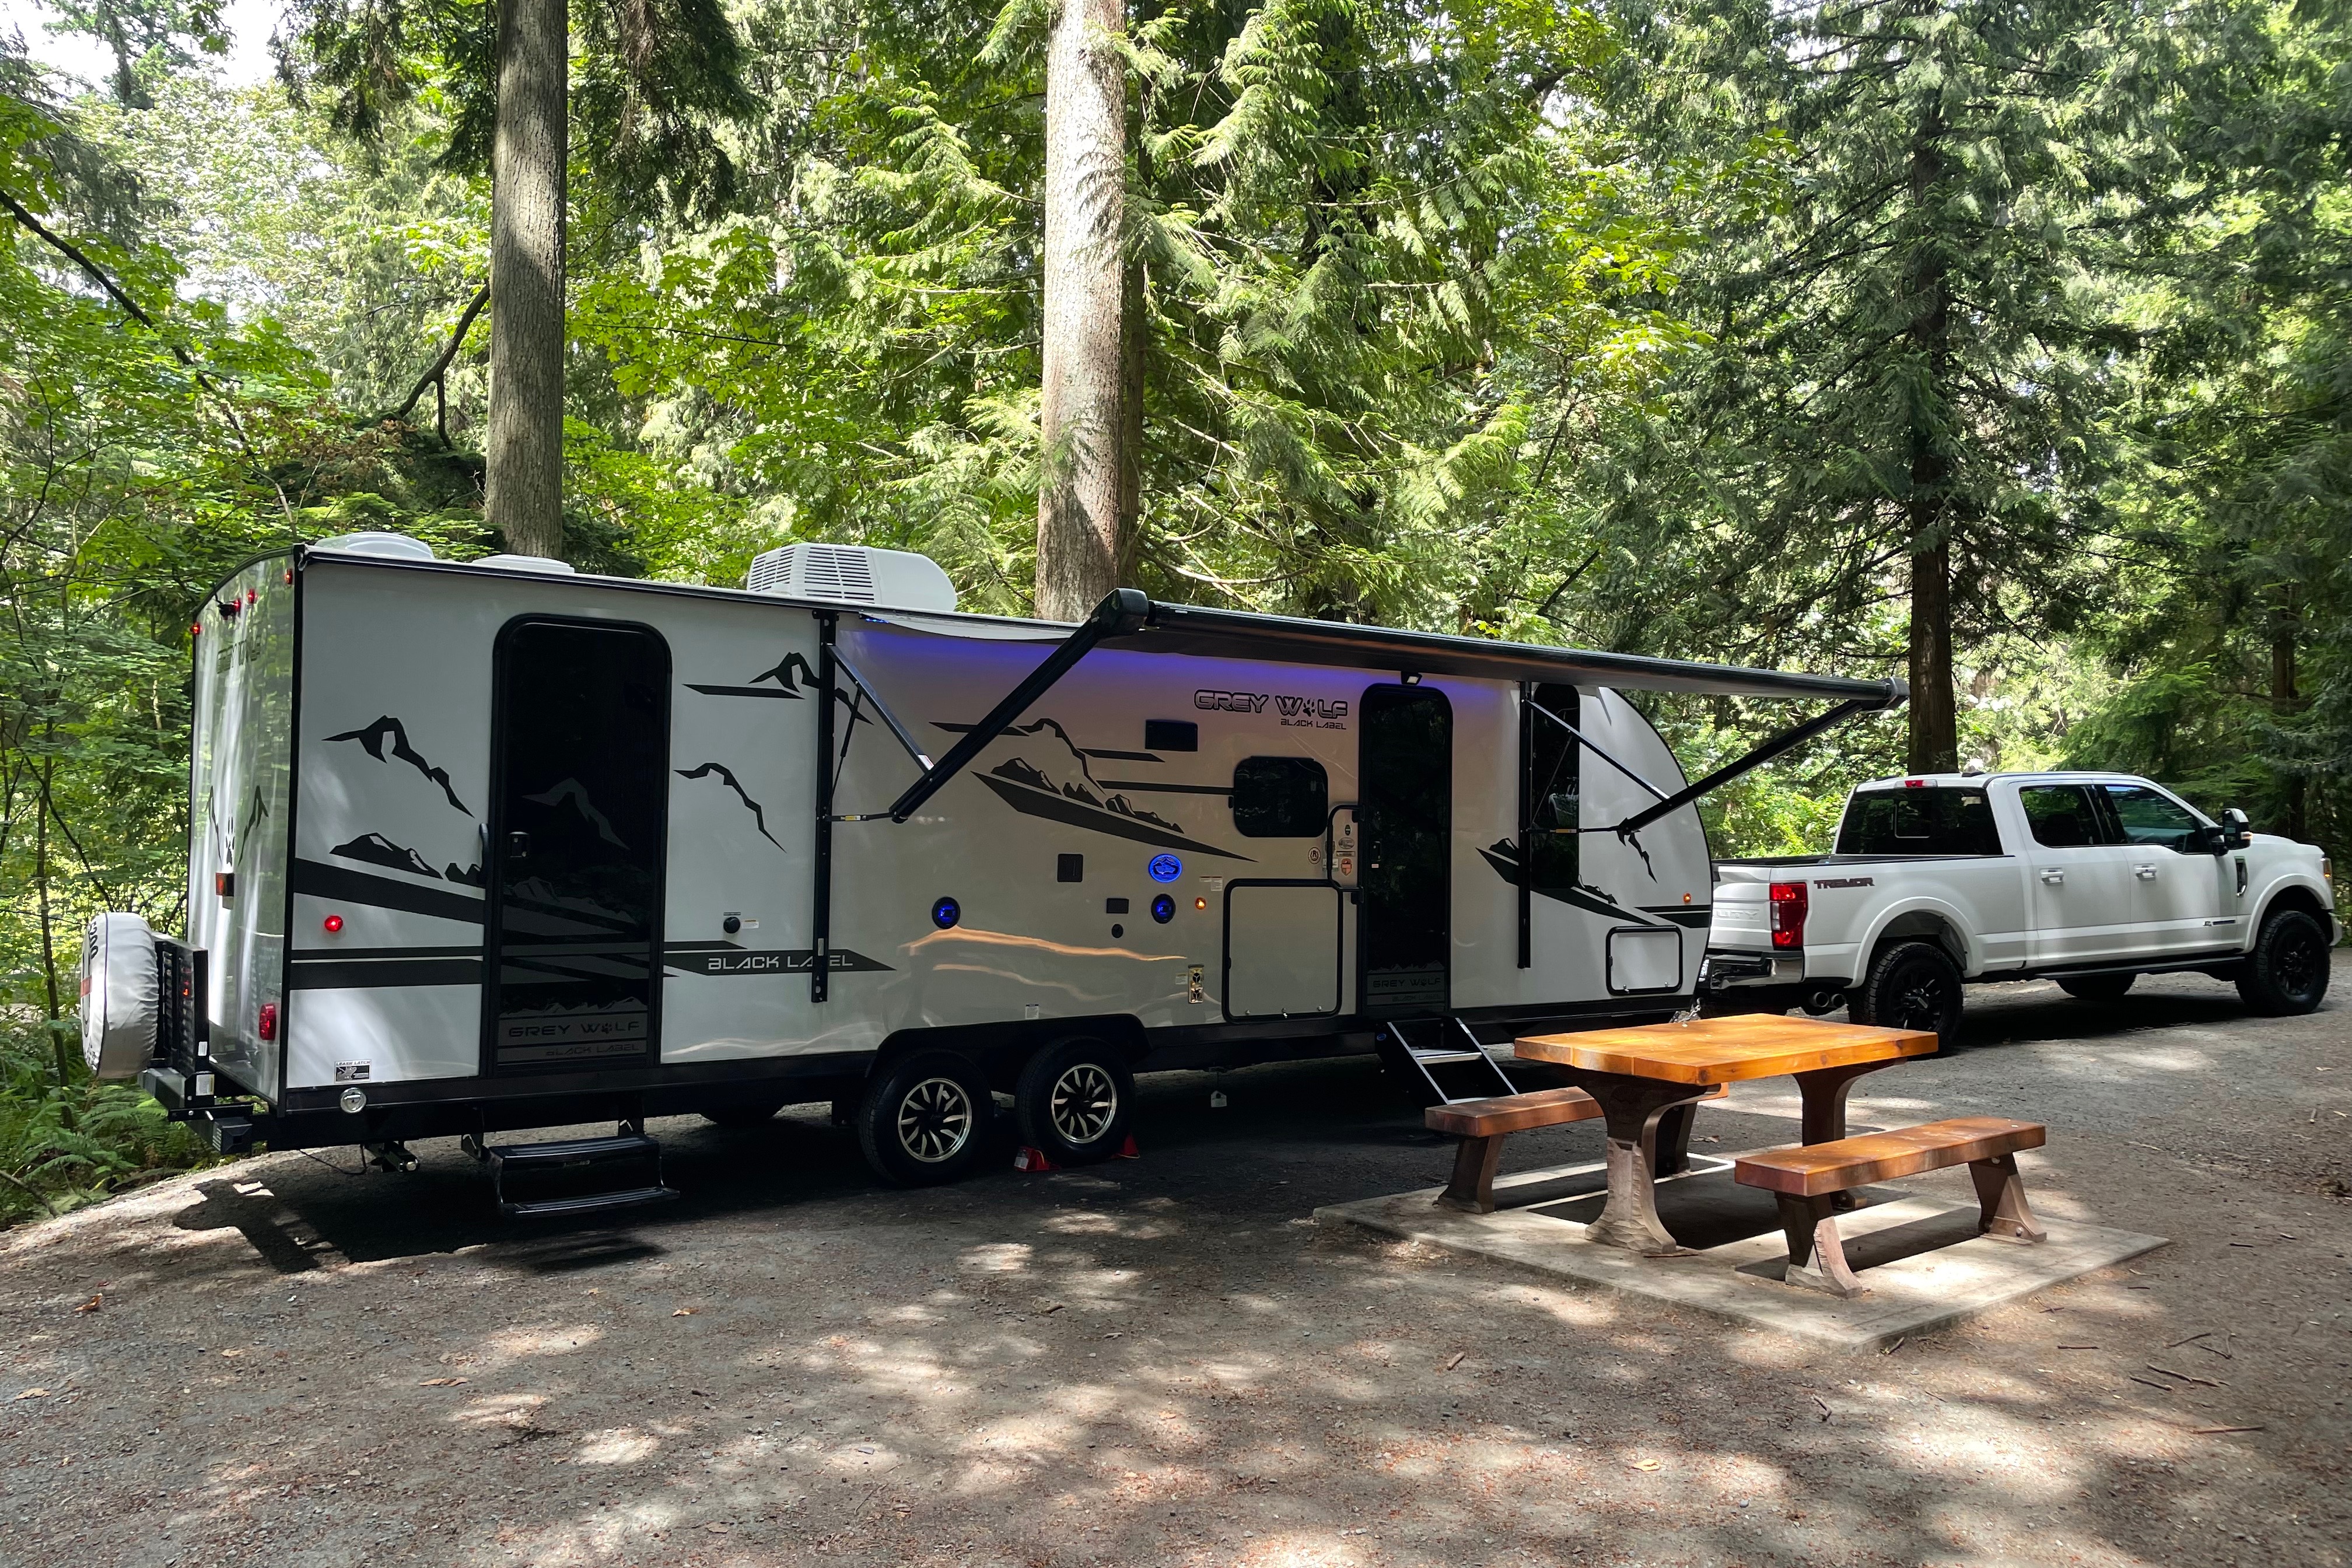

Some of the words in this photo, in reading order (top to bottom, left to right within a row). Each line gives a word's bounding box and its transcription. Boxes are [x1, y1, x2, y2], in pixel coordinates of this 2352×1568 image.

[1194, 689, 1269, 713] GREY
[1280, 718, 1313, 727] BLACK
[1316, 721, 1347, 730] LABEL
[1814, 877, 1875, 889] TREMOR
[708, 956, 779, 970] BLACK
[788, 954, 853, 968] LAEL
[1373, 979, 1405, 988] GREY
[509, 1024, 570, 1037] GREY
[597, 1044, 639, 1053] LABEL
